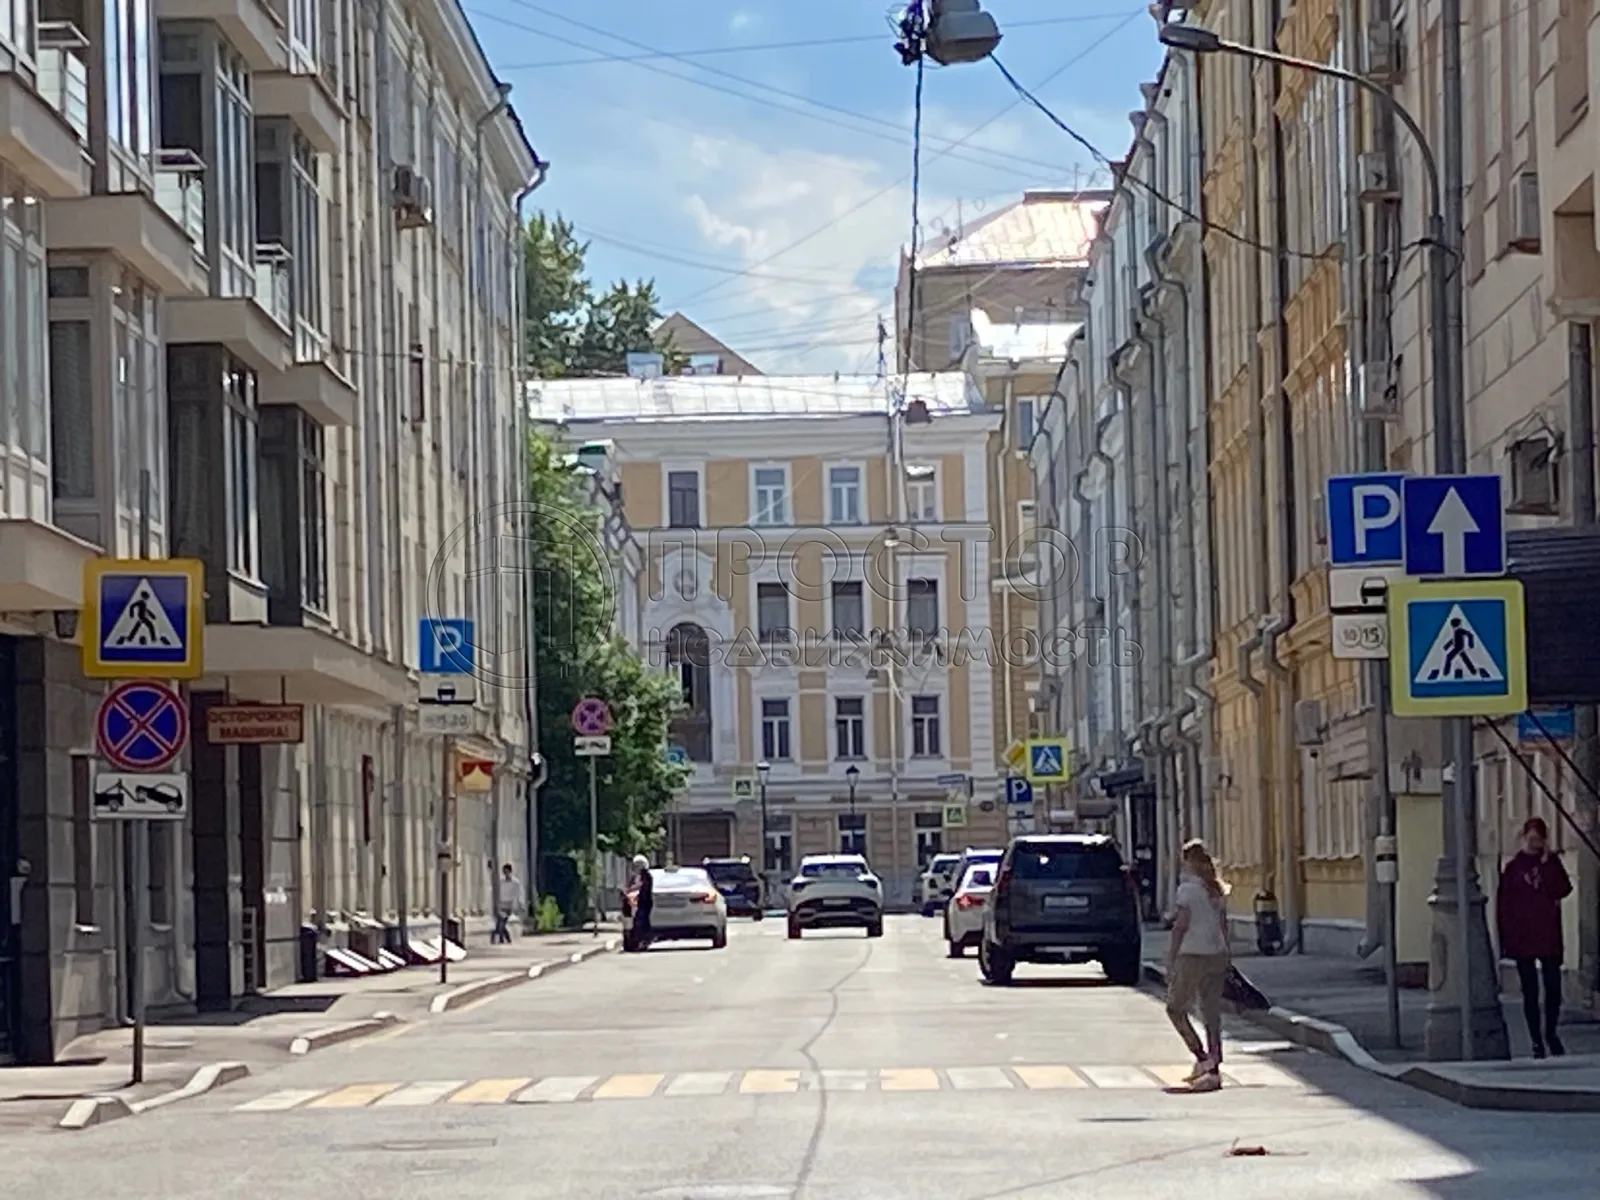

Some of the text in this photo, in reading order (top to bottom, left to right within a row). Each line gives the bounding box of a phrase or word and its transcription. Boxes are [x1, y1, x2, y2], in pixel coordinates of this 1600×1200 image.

[1352, 484, 1400, 554] P
[433, 625, 463, 667] P
[1363, 627, 1380, 643] 15
[1012, 779, 1027, 802] P
